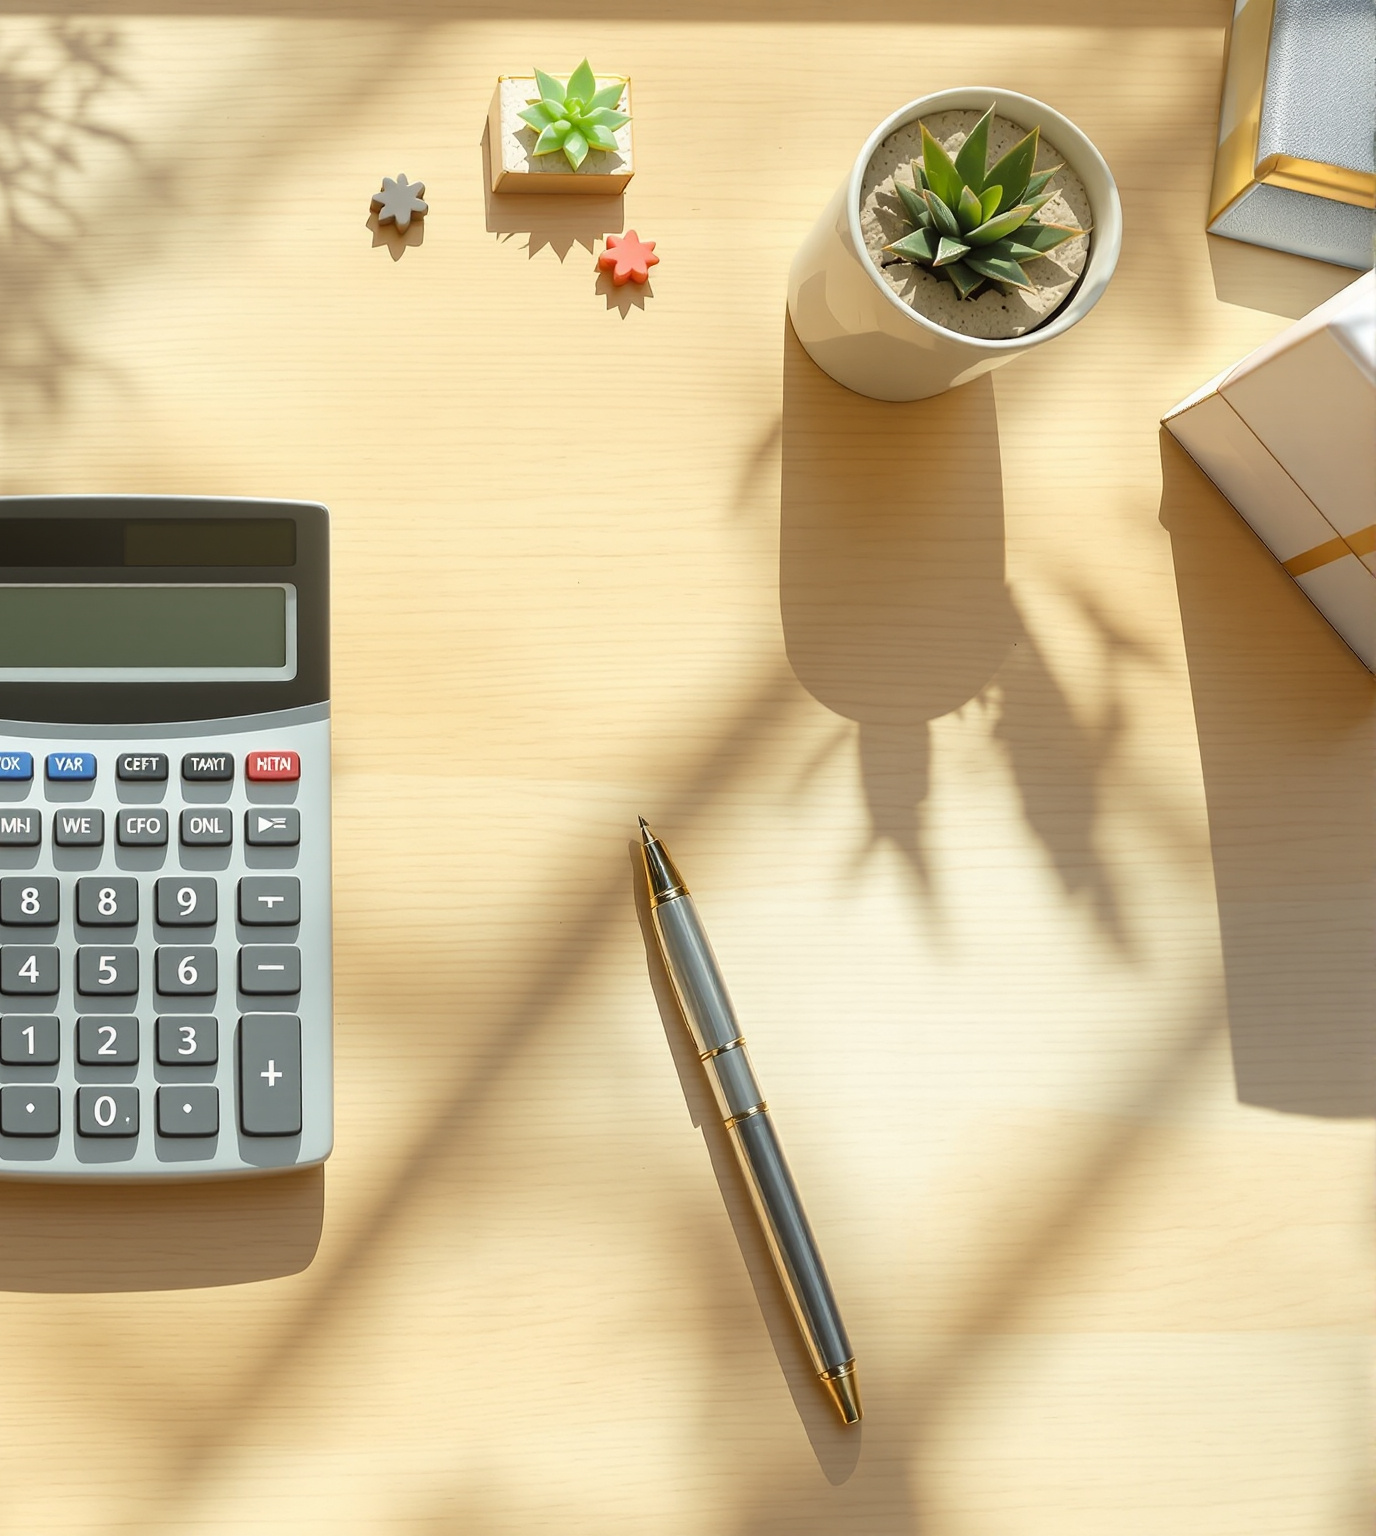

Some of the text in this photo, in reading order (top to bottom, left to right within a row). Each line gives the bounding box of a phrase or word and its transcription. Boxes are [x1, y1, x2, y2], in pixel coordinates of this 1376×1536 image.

[62, 817, 91, 834] WE
[126, 817, 161, 834] CFO
[190, 817, 224, 834] ONL
[20, 887, 40, 915] 8
[97, 887, 117, 916] 8
[177, 887, 197, 916] 9
[18, 955, 40, 983] 4
[98, 955, 117, 985] 5
[177, 955, 198, 985] 6
[22, 1025, 35, 1055] 1
[97, 1025, 117, 1055] 2
[178, 1026, 197, 1055] 3
